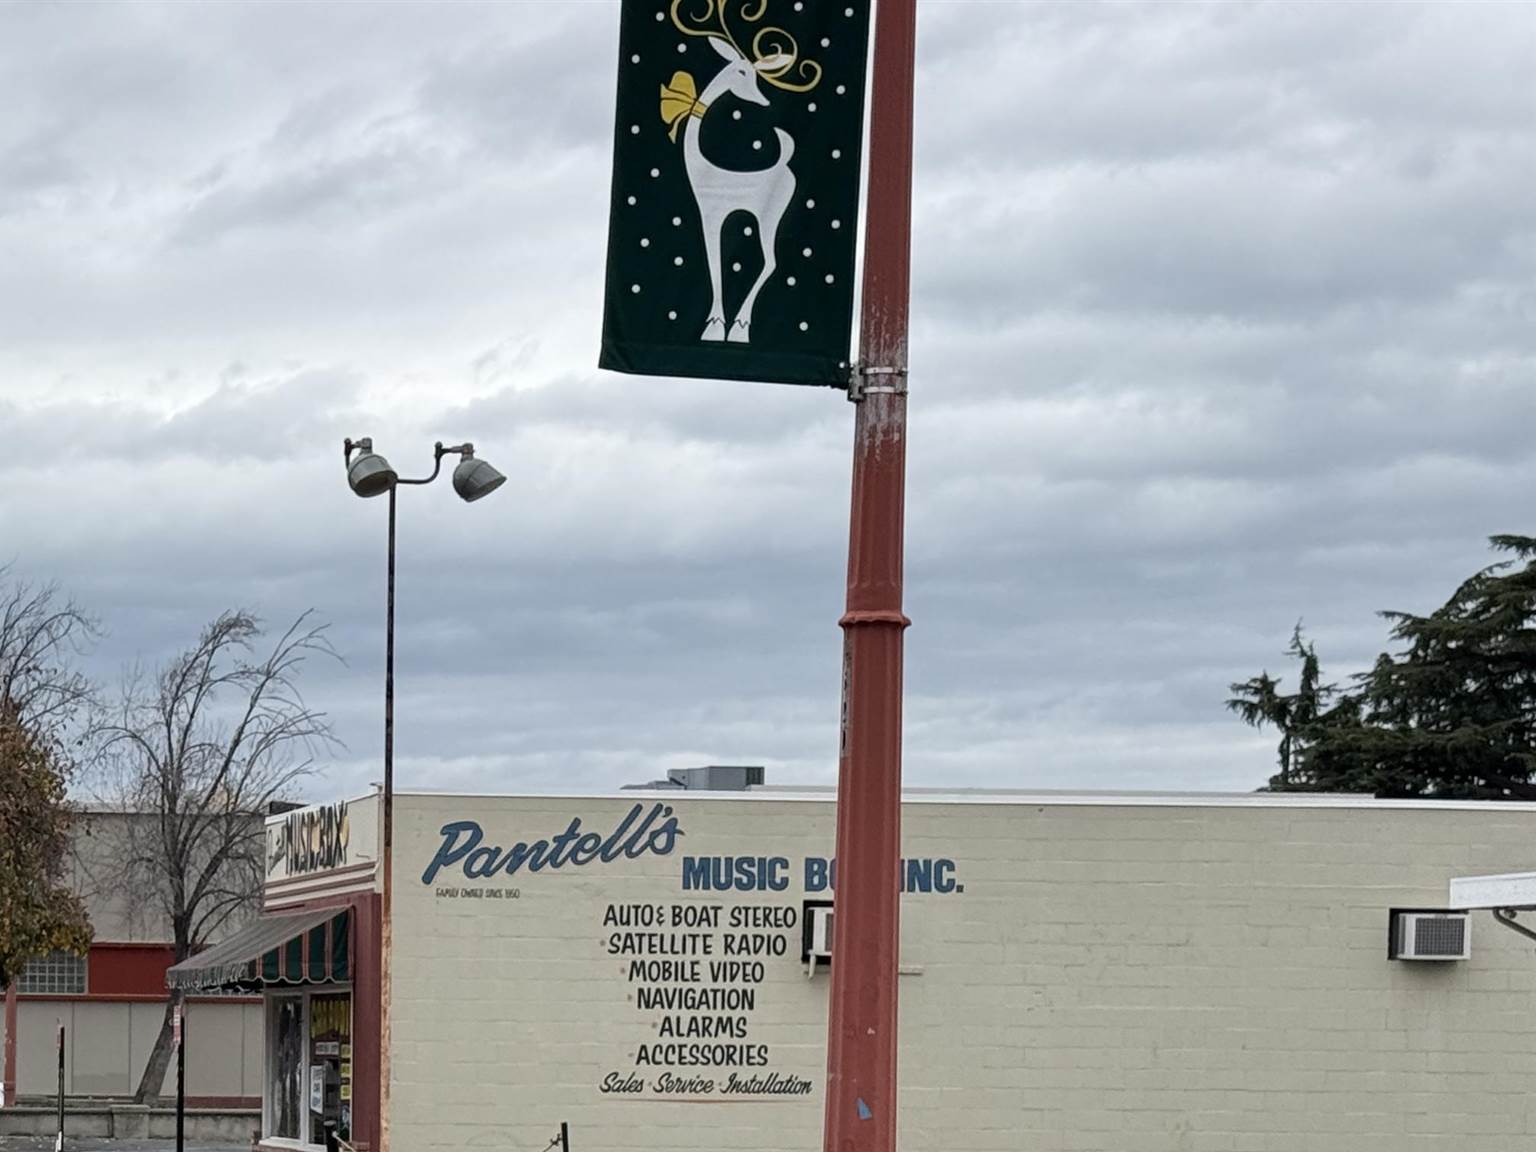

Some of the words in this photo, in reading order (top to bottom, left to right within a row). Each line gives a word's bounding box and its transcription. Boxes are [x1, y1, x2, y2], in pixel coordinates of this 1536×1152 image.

[422, 803, 686, 885] Pantell's
[682, 856, 790, 893] MUSIC
[671, 905, 723, 928] BOAT
[728, 906, 797, 928] STEREO
[607, 932, 713, 956] SATELLITE
[723, 934, 787, 956] RADIO
[628, 960, 701, 982] MOBILE
[709, 961, 765, 983] VIDEO
[637, 987, 755, 1010] NAVIGATION
[658, 1016, 748, 1038] ALARMS
[635, 1044, 769, 1066] ACCESSORIES
[599, 1071, 645, 1093] Sales
[652, 1071, 715, 1094] Service
[719, 1072, 813, 1095] Installation
